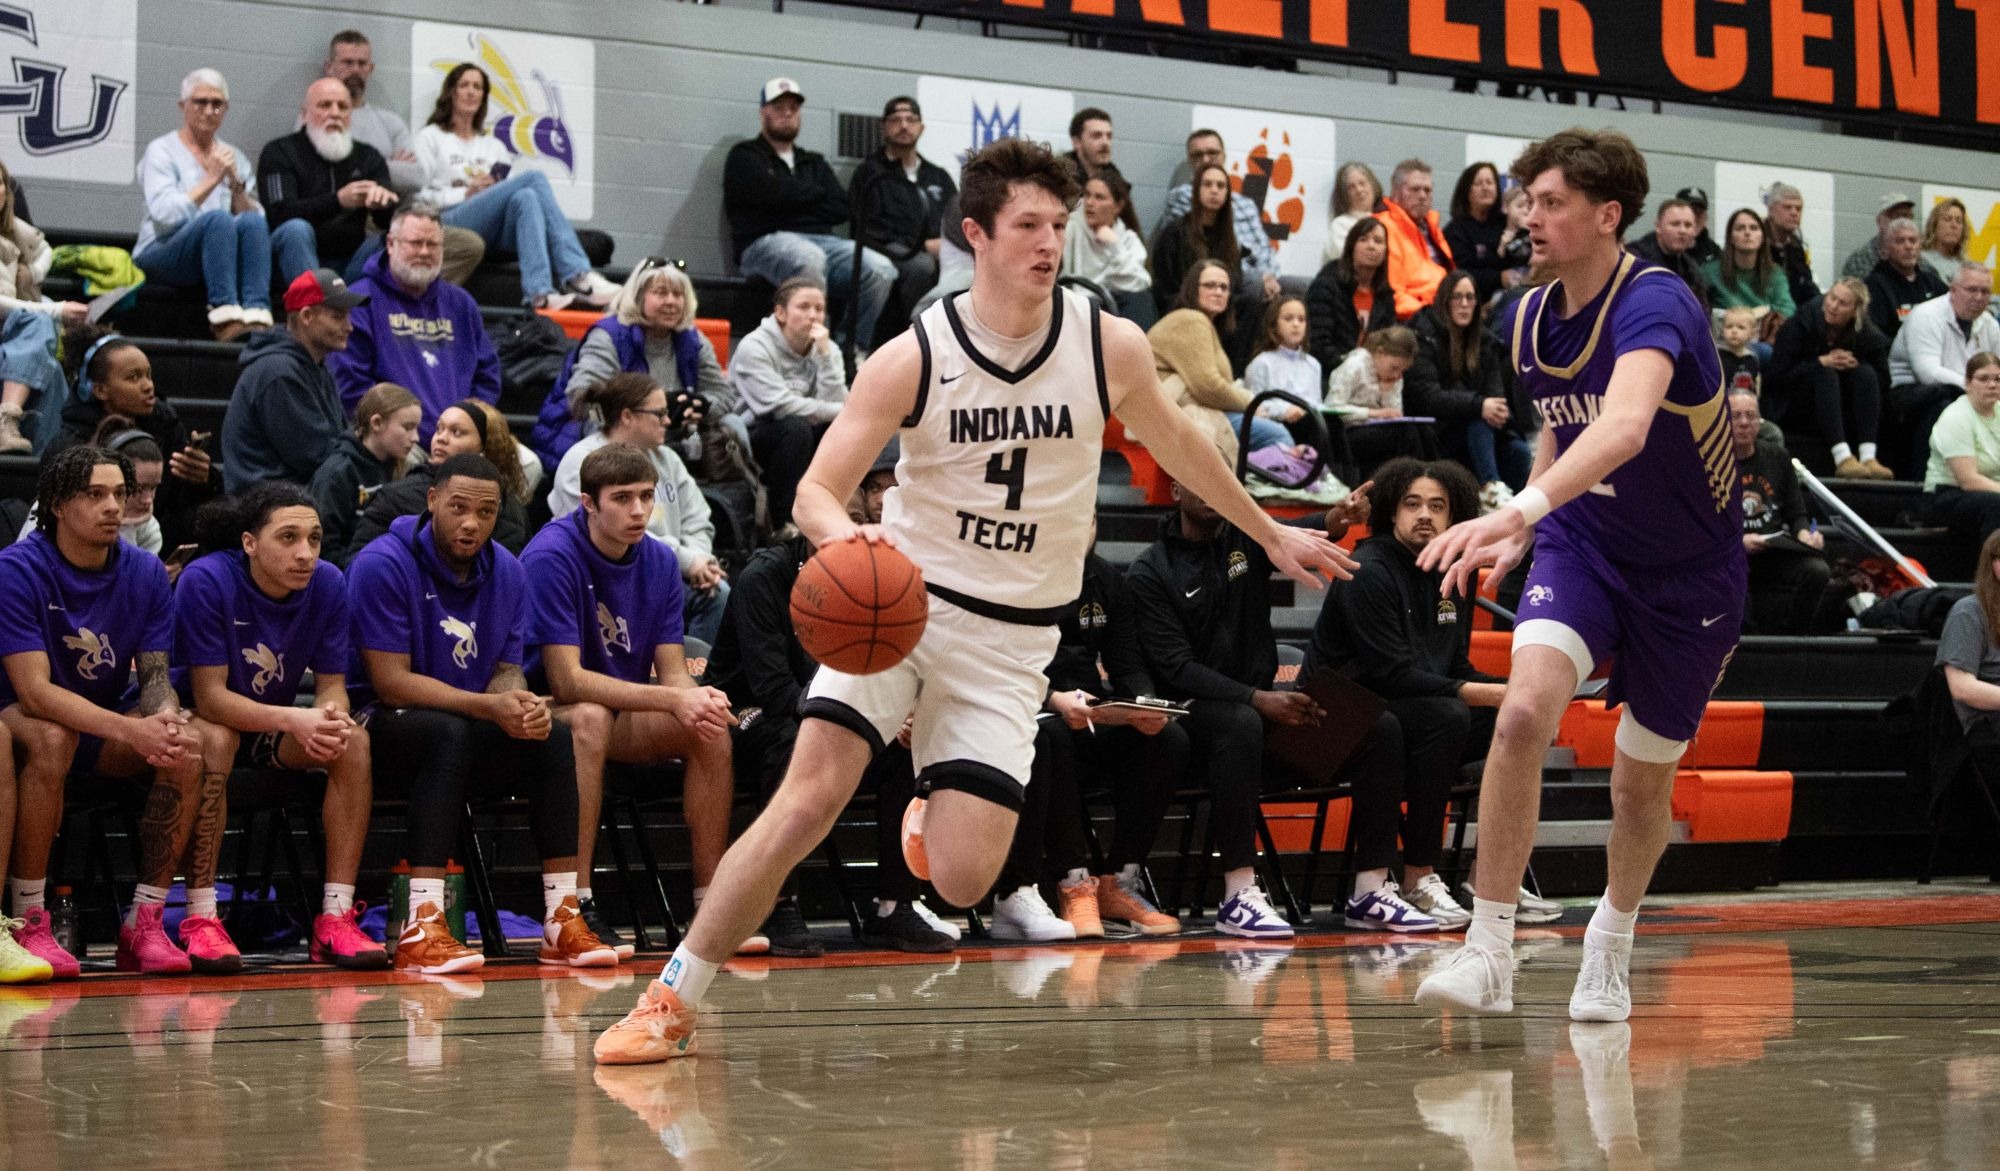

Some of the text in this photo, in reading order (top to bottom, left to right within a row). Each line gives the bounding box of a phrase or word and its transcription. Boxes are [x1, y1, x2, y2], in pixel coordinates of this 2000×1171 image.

[949, 404, 1074, 443] INDIANA
[1533, 393, 1605, 429] EFIAN
[984, 447, 1028, 511] 4
[956, 510, 1038, 553] TECH
